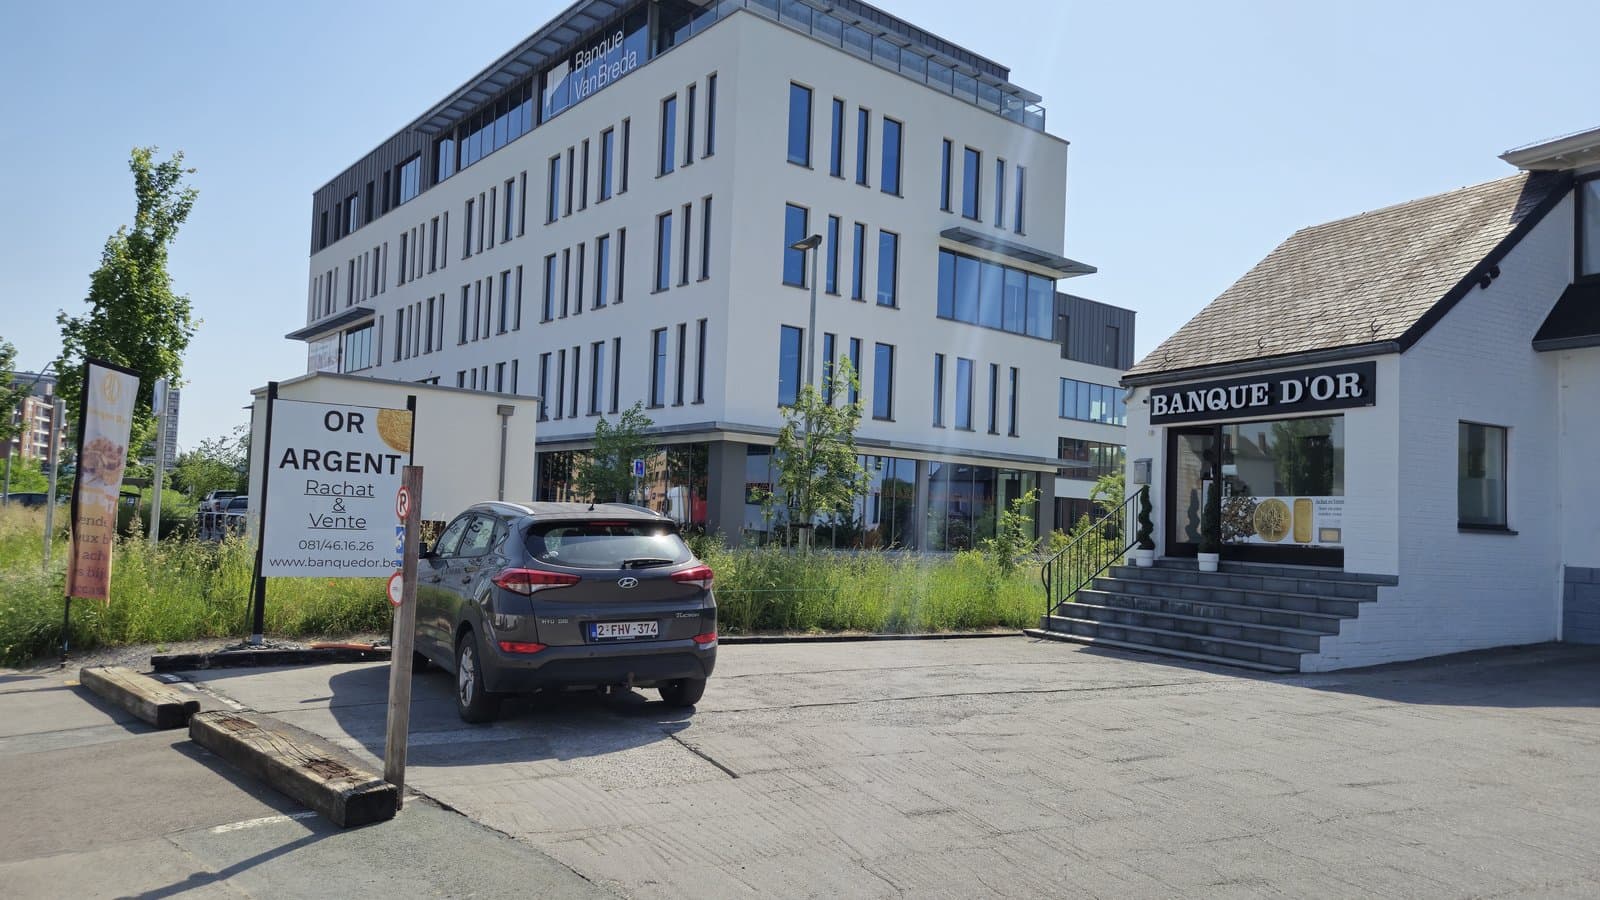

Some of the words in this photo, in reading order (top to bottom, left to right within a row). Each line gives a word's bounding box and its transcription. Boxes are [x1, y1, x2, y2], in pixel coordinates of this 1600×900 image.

[575, 30, 624, 74] Banque
[1151, 381, 1269, 416] BANQUE
[1279, 372, 1363, 404] D'OR
[323, 410, 365, 434] OR
[278, 447, 402, 475] ARGENT
[305, 479, 375, 497] Rachat
[332, 497, 347, 512] &
[308, 513, 368, 529] Vente
[298, 539, 375, 551] 081/46.16.26
[269, 556, 398, 569] www.banquedor.be
